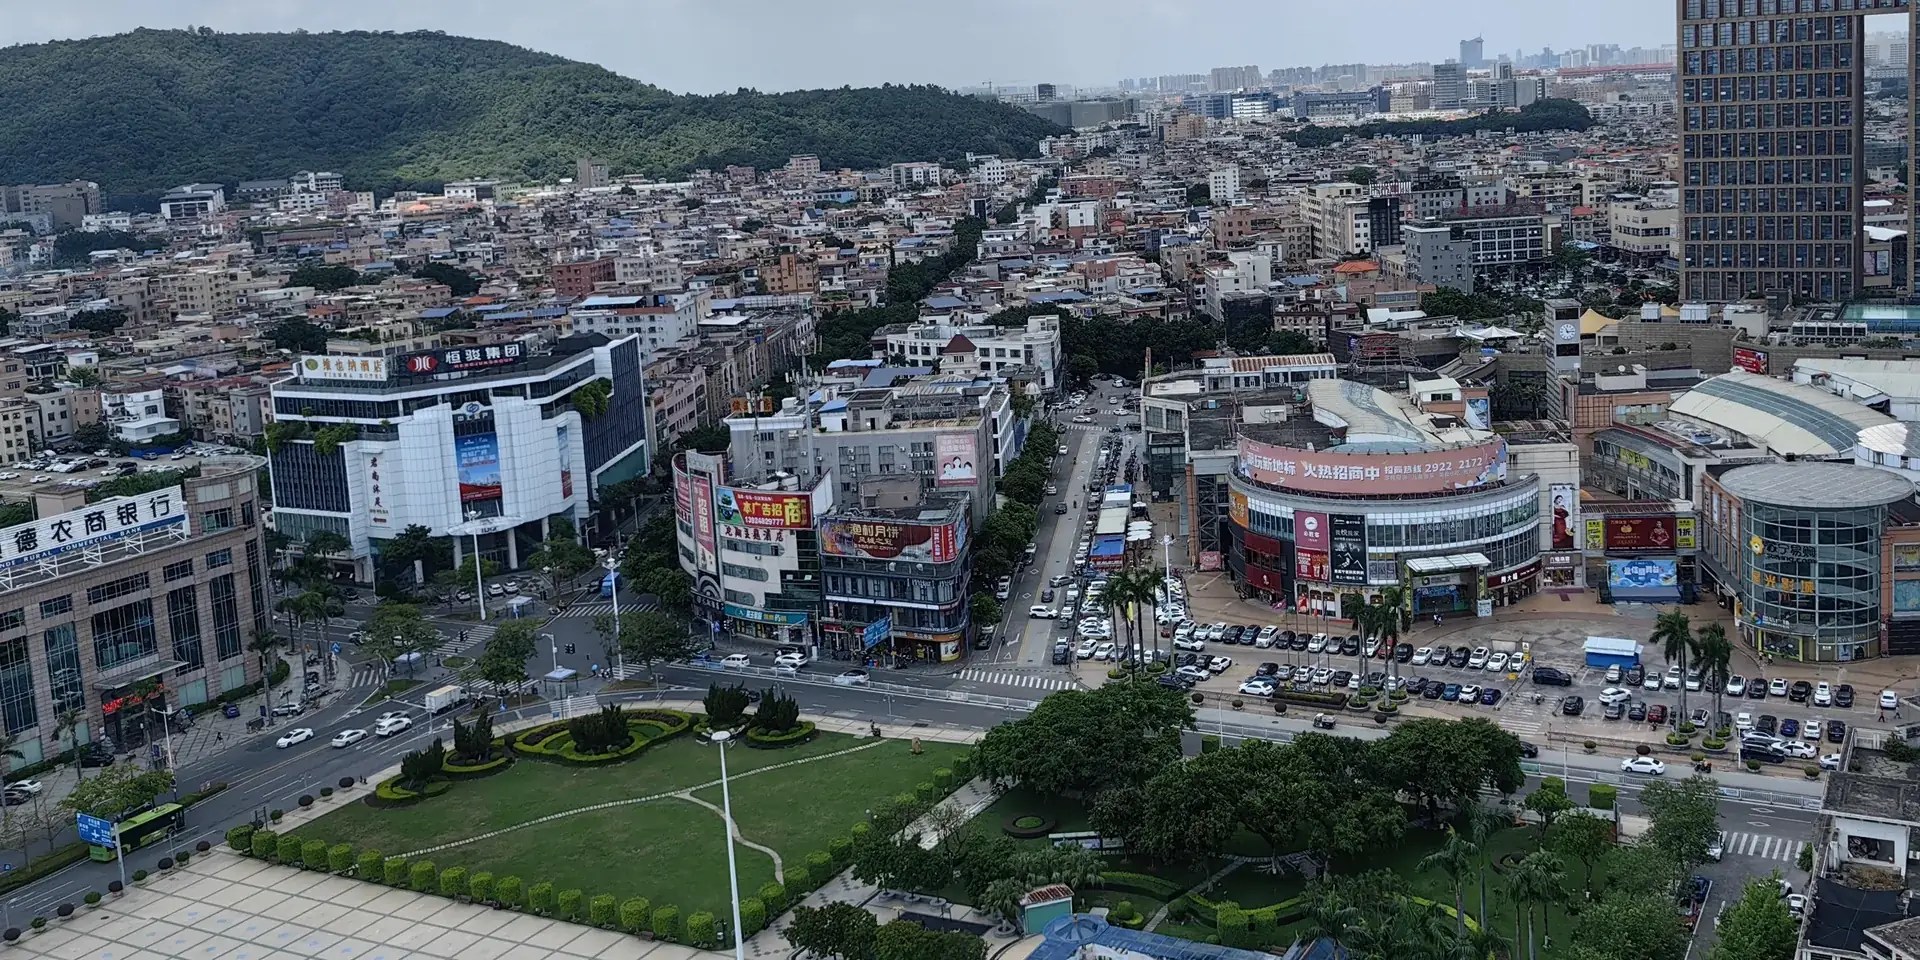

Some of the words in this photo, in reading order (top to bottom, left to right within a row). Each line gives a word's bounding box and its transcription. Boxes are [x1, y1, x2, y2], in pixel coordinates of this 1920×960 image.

[445, 344, 520, 364] 恒骏集团
[322, 358, 383, 372] 维也纳酒店
[1304, 463, 1380, 481] 火热招商中
[1425, 462, 1453, 473] 2922
[1459, 457, 1483, 469] 2172
[698, 497, 709, 534] 招租
[0, 494, 170, 559] 德农商银行
[23, 551, 53, 562] RURAL
[60, 534, 114, 553] COMMERCIAL
[120, 527, 142, 538] BANK
[1766, 541, 1816, 558] 苏宁易购
[1501, 572, 1518, 584] 周大福
